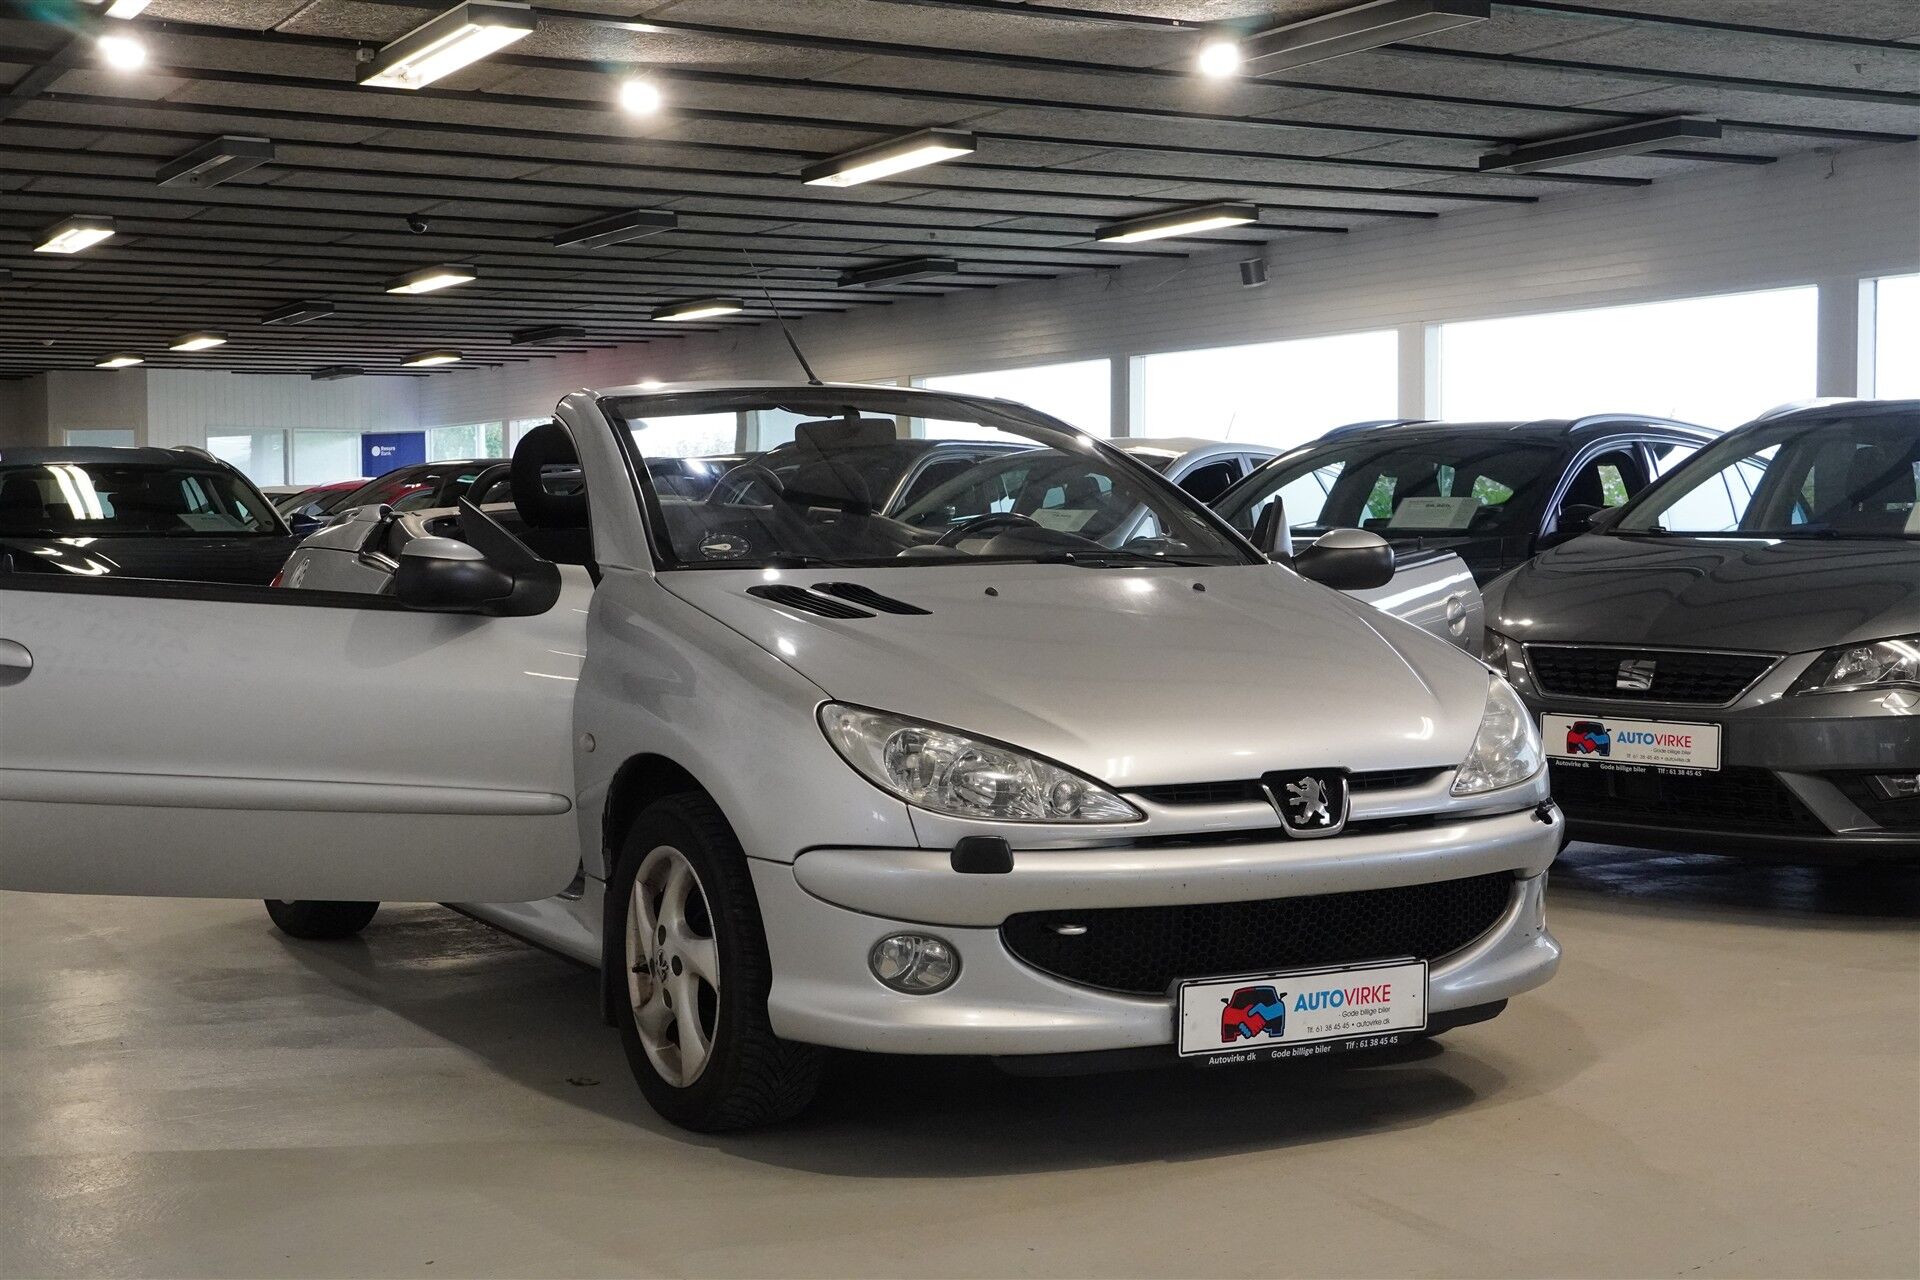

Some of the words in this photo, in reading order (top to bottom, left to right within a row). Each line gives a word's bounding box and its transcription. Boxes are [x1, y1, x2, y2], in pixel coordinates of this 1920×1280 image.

[1616, 731, 1692, 748] AUTOVIRKE
[1293, 984, 1391, 1012] AUTOVIRKE
[1316, 1025, 1323, 1033] 61
[1369, 1038, 1378, 1046] 38
[1380, 1037, 1388, 1045] 45
[1389, 1035, 1398, 1043] 45
[1271, 1049, 1290, 1058] Gode
[1292, 1047, 1313, 1056] billige
[1315, 1045, 1331, 1053] biler
[1208, 1053, 1245, 1064] Autovirke
